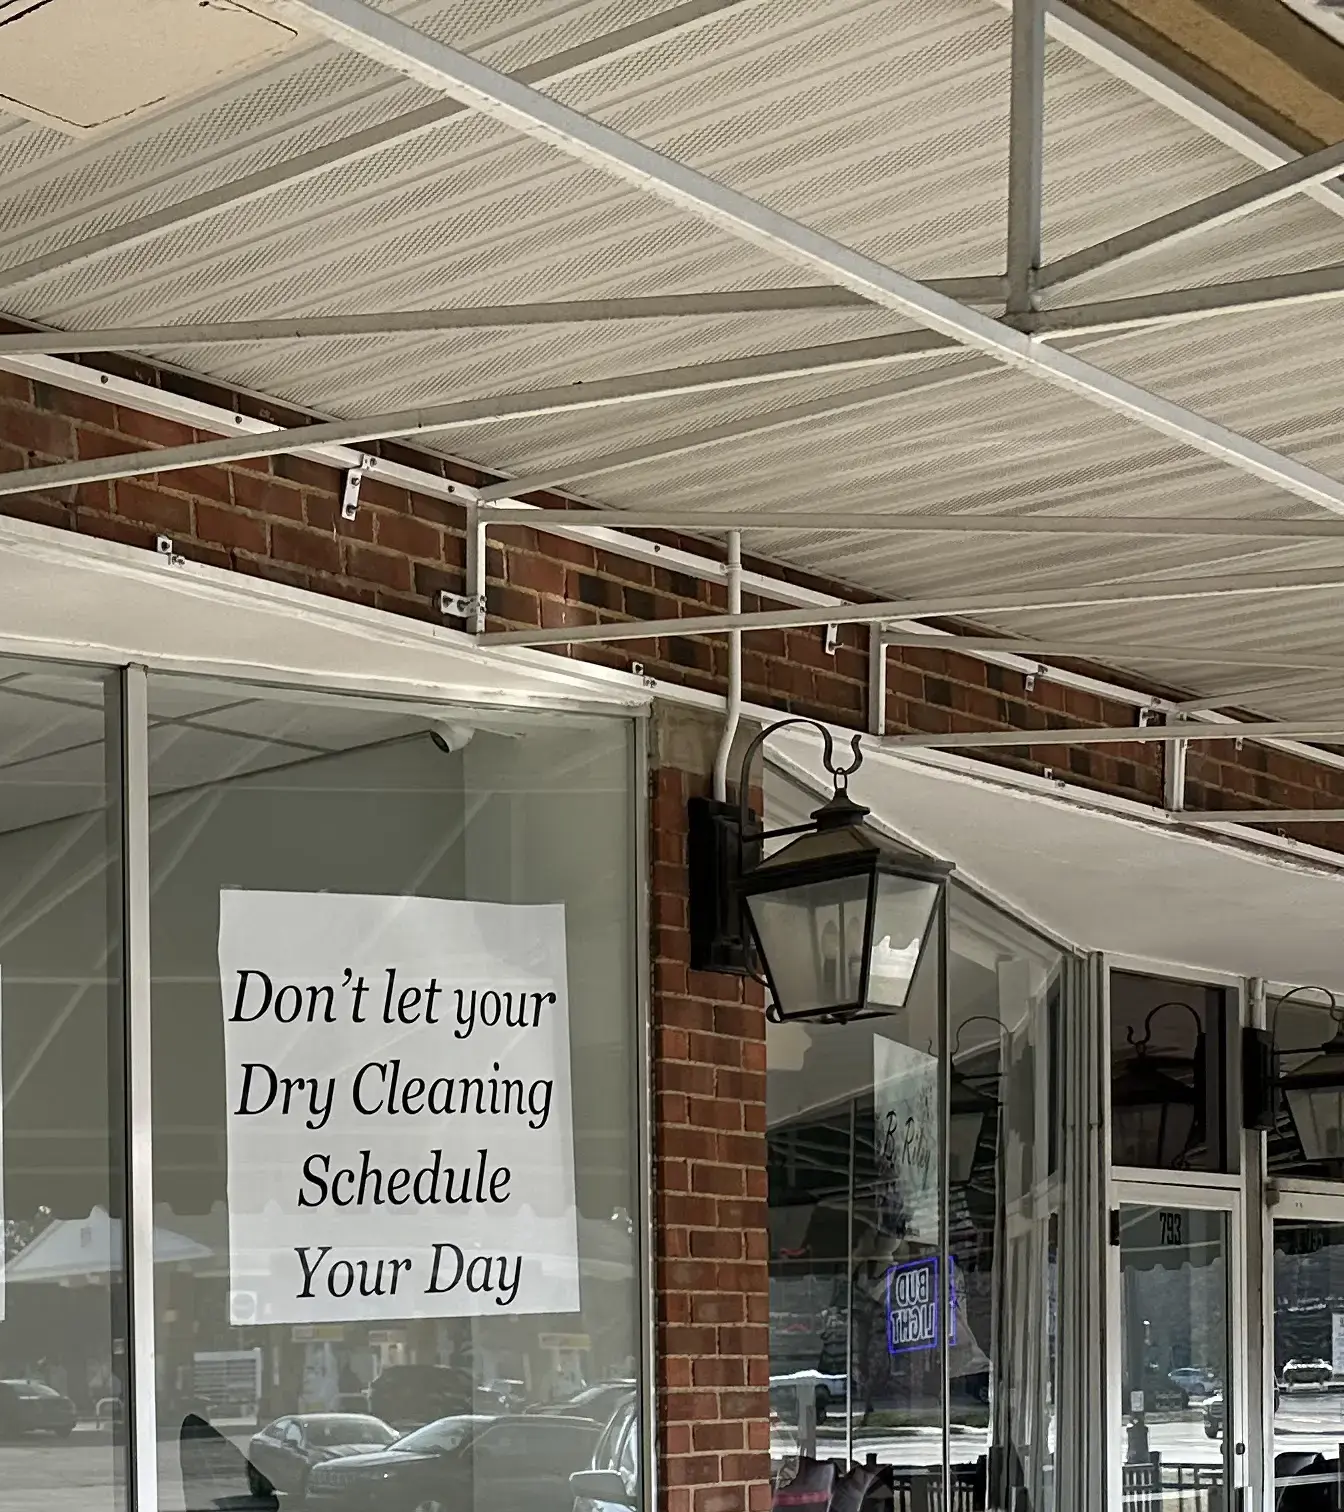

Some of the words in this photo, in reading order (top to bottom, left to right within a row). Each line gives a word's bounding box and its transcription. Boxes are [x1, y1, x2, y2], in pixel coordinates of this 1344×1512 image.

[383, 968, 443, 1025] let
[454, 987, 557, 1039] your
[234, 1062, 336, 1129] Dry
[352, 1060, 554, 1129] Cleaning
[297, 1148, 512, 1207] Schedule
[1160, 1212, 1182, 1245] 793
[293, 1245, 412, 1299] Your
[424, 1243, 523, 1305] Day
